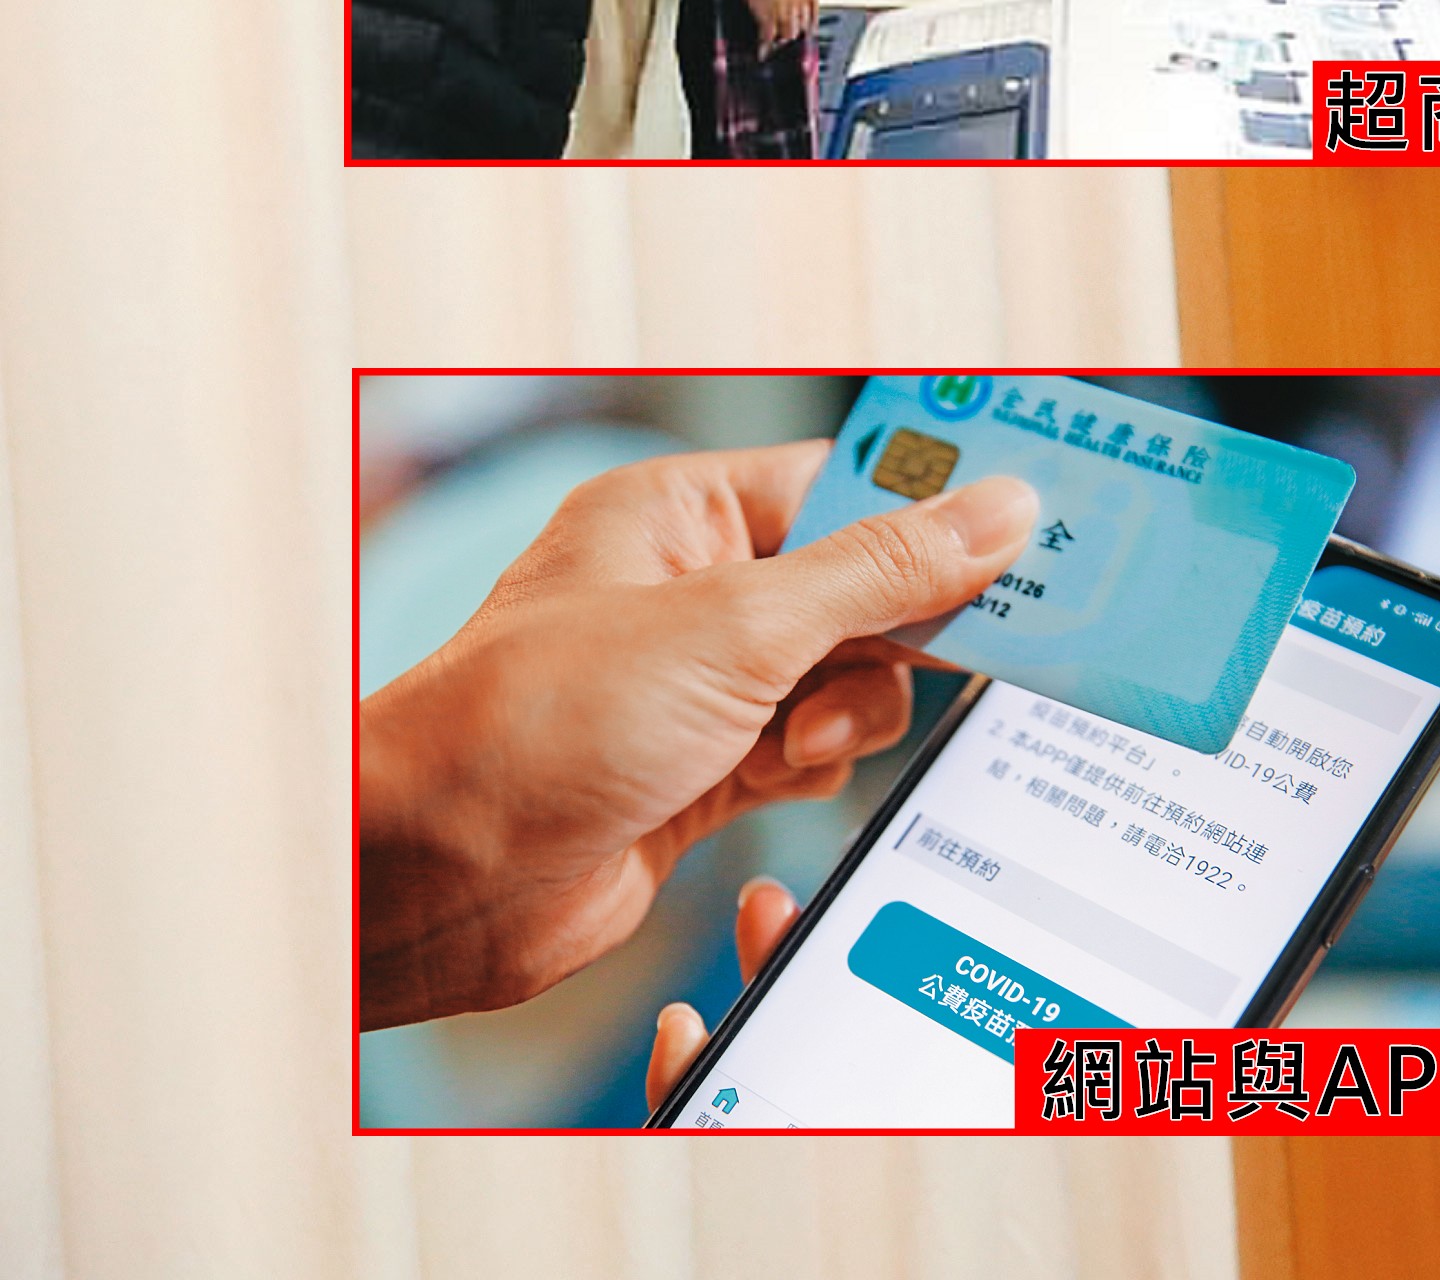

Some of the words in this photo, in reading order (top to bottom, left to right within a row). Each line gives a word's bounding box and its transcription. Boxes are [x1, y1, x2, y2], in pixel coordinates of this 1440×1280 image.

[1038, 519, 1075, 552] 全
[993, 572, 1046, 599] 0126
[1297, 598, 1386, 646] 疫苗預約
[917, 827, 1001, 882] 前往預約
[955, 955, 1061, 1022] COVID-19
